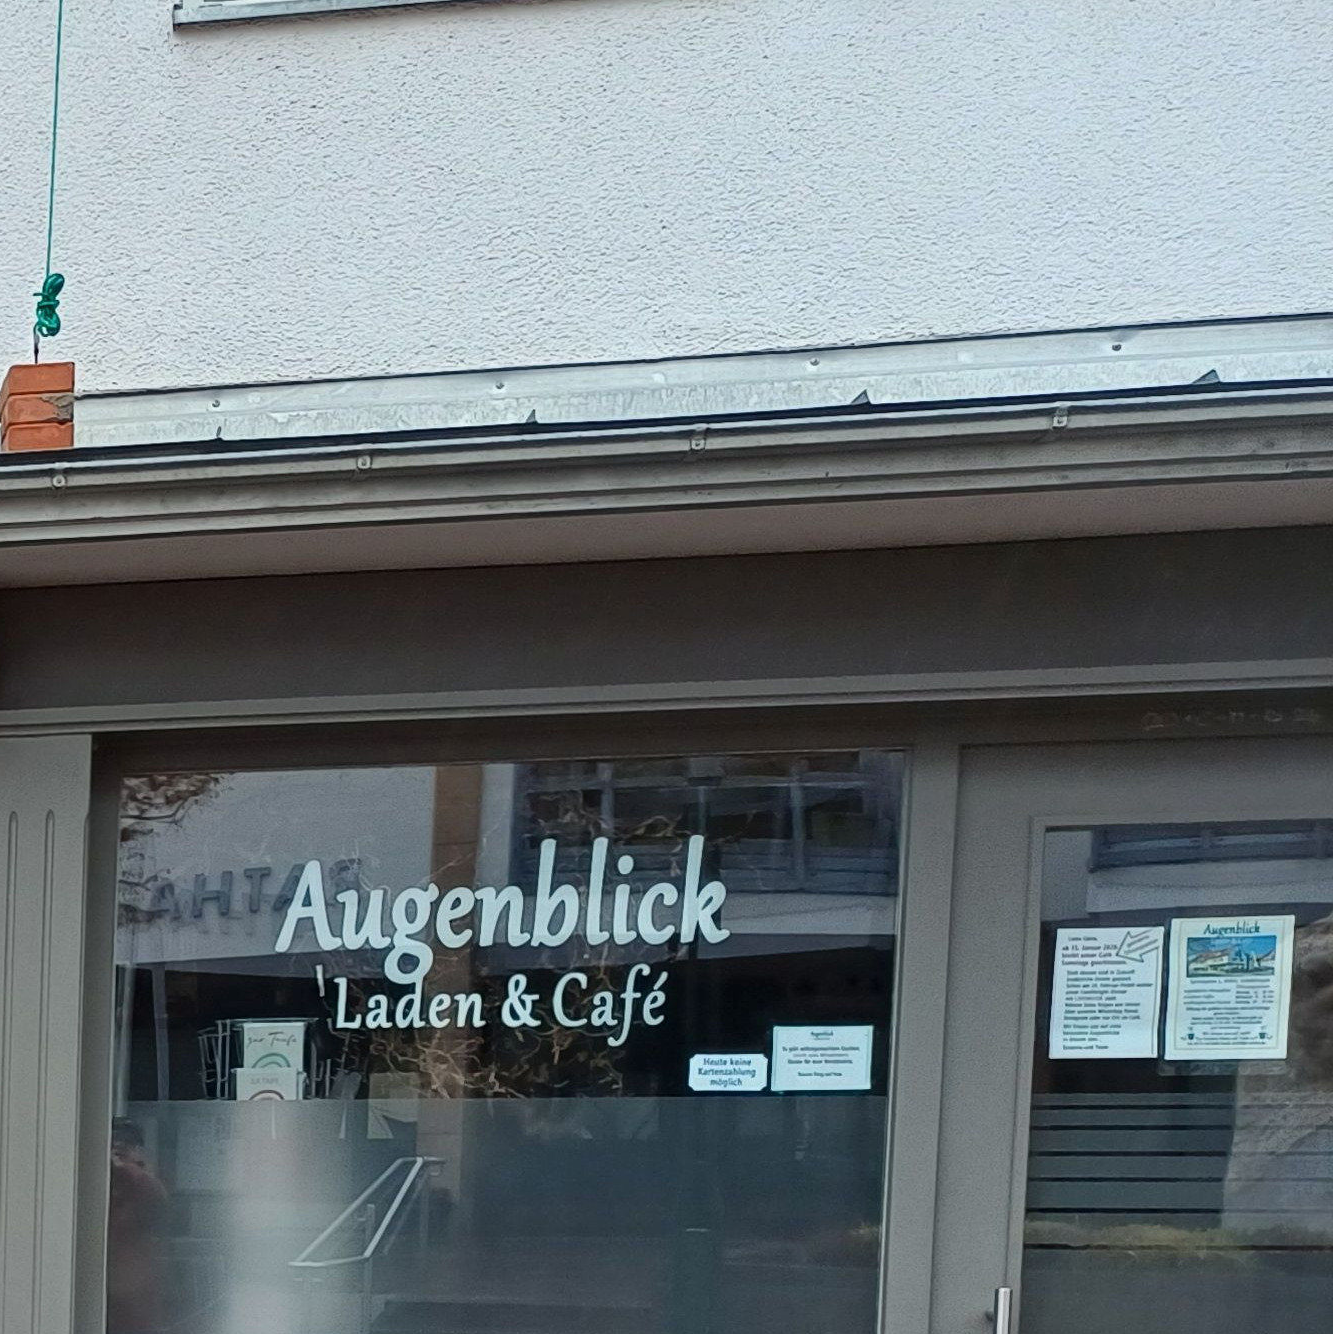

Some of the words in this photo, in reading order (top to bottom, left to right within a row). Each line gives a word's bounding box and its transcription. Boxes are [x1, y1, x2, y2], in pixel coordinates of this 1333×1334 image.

[274, 835, 730, 983] Augenblick
[1203, 921, 1260, 939] Augenblick
[333, 976, 486, 1029] Laden
[501, 973, 541, 1028] &
[553, 963, 669, 1047] Café
[703, 1057, 728, 1066] Heute
[730, 1057, 752, 1066] keine
[698, 1068, 757, 1078] Kartenzahlung
[710, 1078, 743, 1087] möglich
